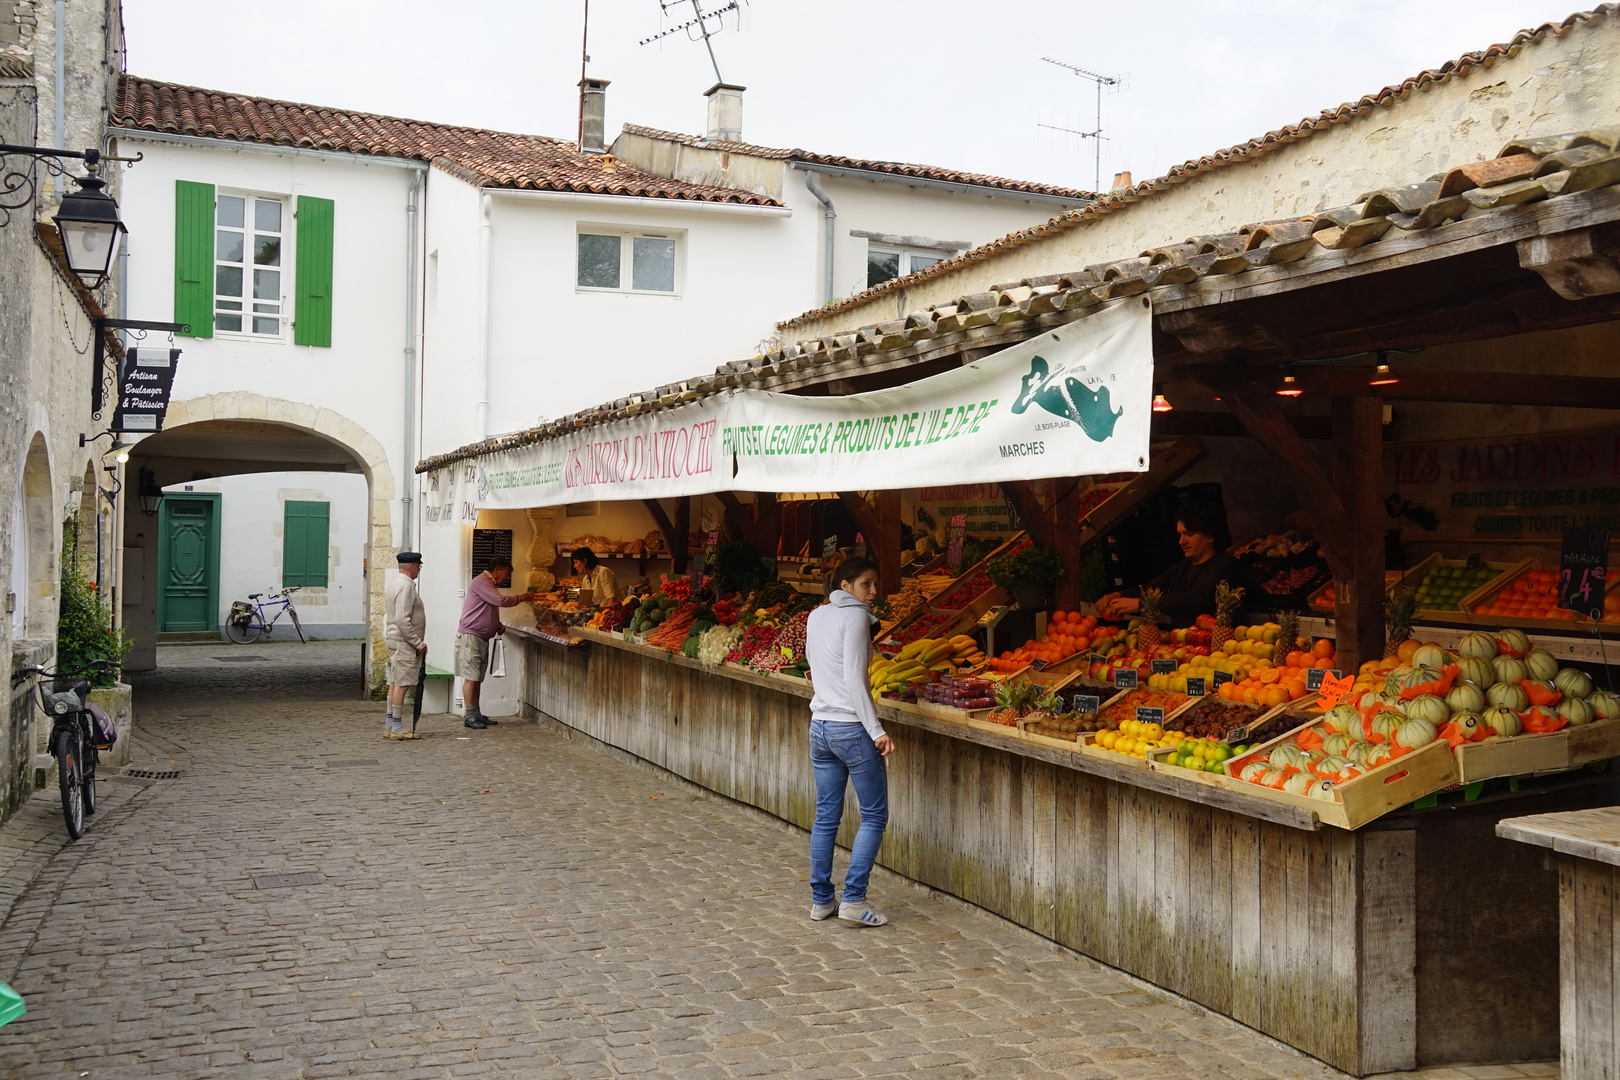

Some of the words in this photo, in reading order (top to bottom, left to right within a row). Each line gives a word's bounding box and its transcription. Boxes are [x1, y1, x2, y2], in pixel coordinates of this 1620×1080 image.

[128, 369, 158, 380] Artisan
[125, 383, 162, 397] Boulanger
[122, 397, 129, 408] &
[131, 397, 164, 409] Pâtissier
[722, 426, 752, 456] FRUITS
[752, 425, 763, 455] ET
[765, 423, 822, 455] LEGUMES
[819, 422, 832, 454] &
[831, 415, 897, 453] PRODUITS
[894, 412, 919, 448] DE
[943, 403, 976, 440] DE
[583, 436, 629, 486] JARDINS
[630, 418, 717, 481] D'ANTIOCHE
[999, 441, 1045, 458] MARCHES
[1393, 448, 1441, 485] LES
[1450, 438, 1595, 482] JARDINS
[1451, 491, 1491, 507] FRUITS
[1495, 490, 1511, 506] ET
[1513, 488, 1574, 506] LEGUMES
[1578, 488, 1587, 504] &
[1475, 516, 1523, 532] OUVERT
[1528, 515, 1568, 531] TOUTE
